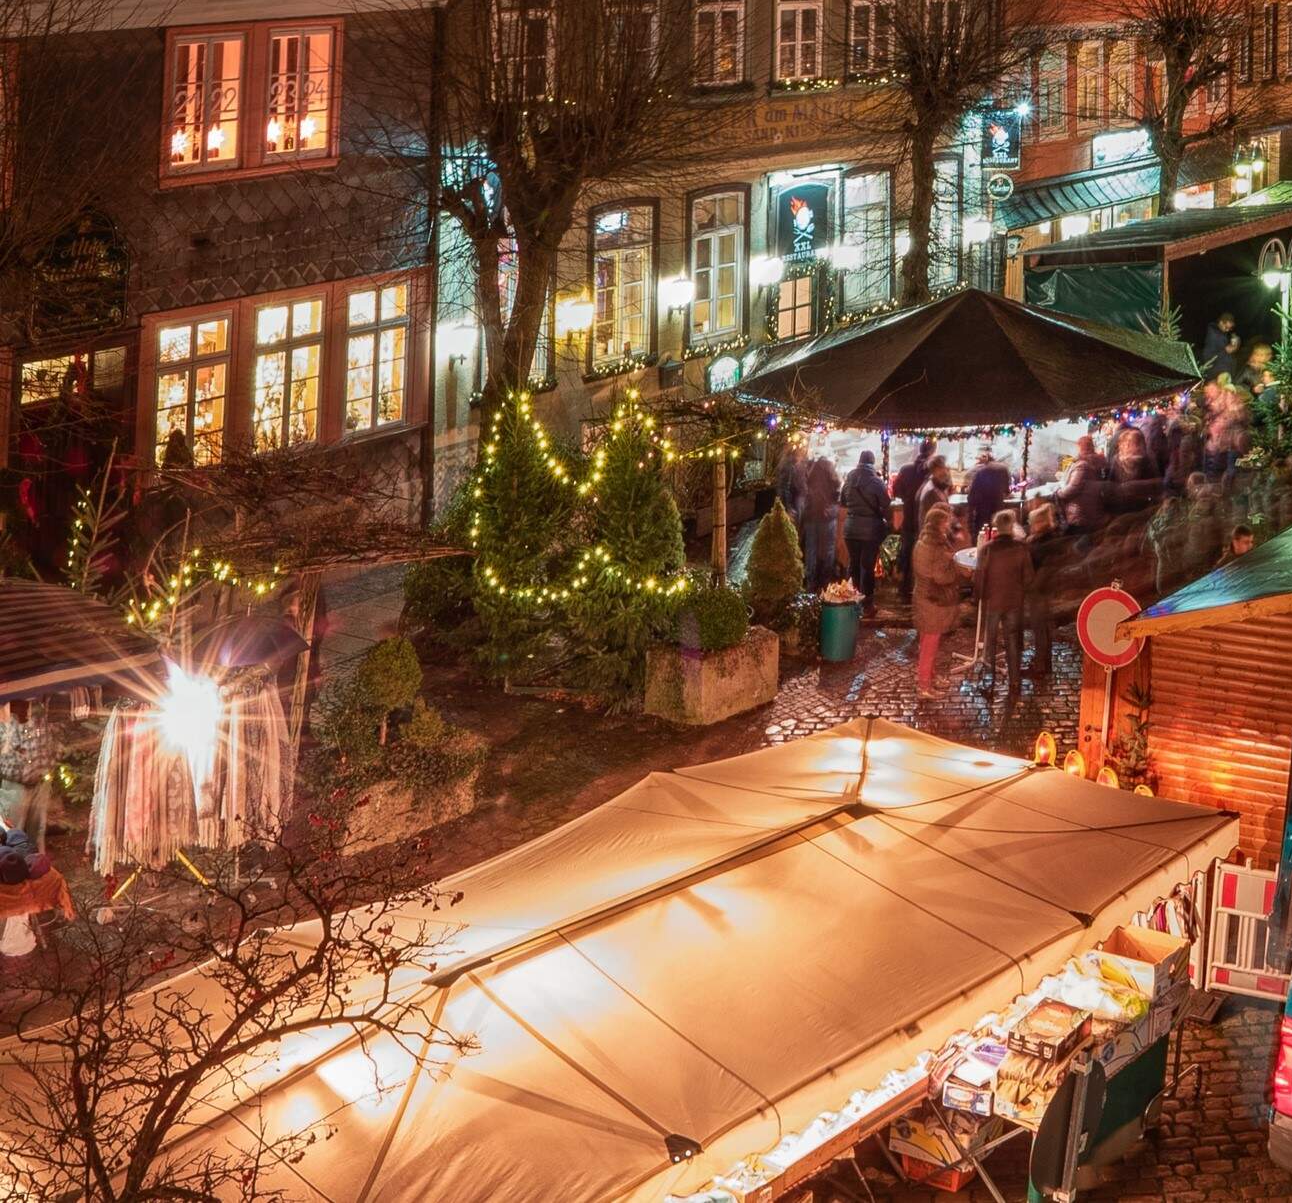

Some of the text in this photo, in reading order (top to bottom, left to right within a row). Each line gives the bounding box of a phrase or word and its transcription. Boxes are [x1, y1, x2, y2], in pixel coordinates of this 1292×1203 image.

[174, 89, 204, 118] 21
[210, 87, 237, 116] 22
[268, 79, 298, 110] 23
[304, 79, 326, 106] 24
[765, 109, 787, 123] am
[794, 241, 812, 252] XXL
